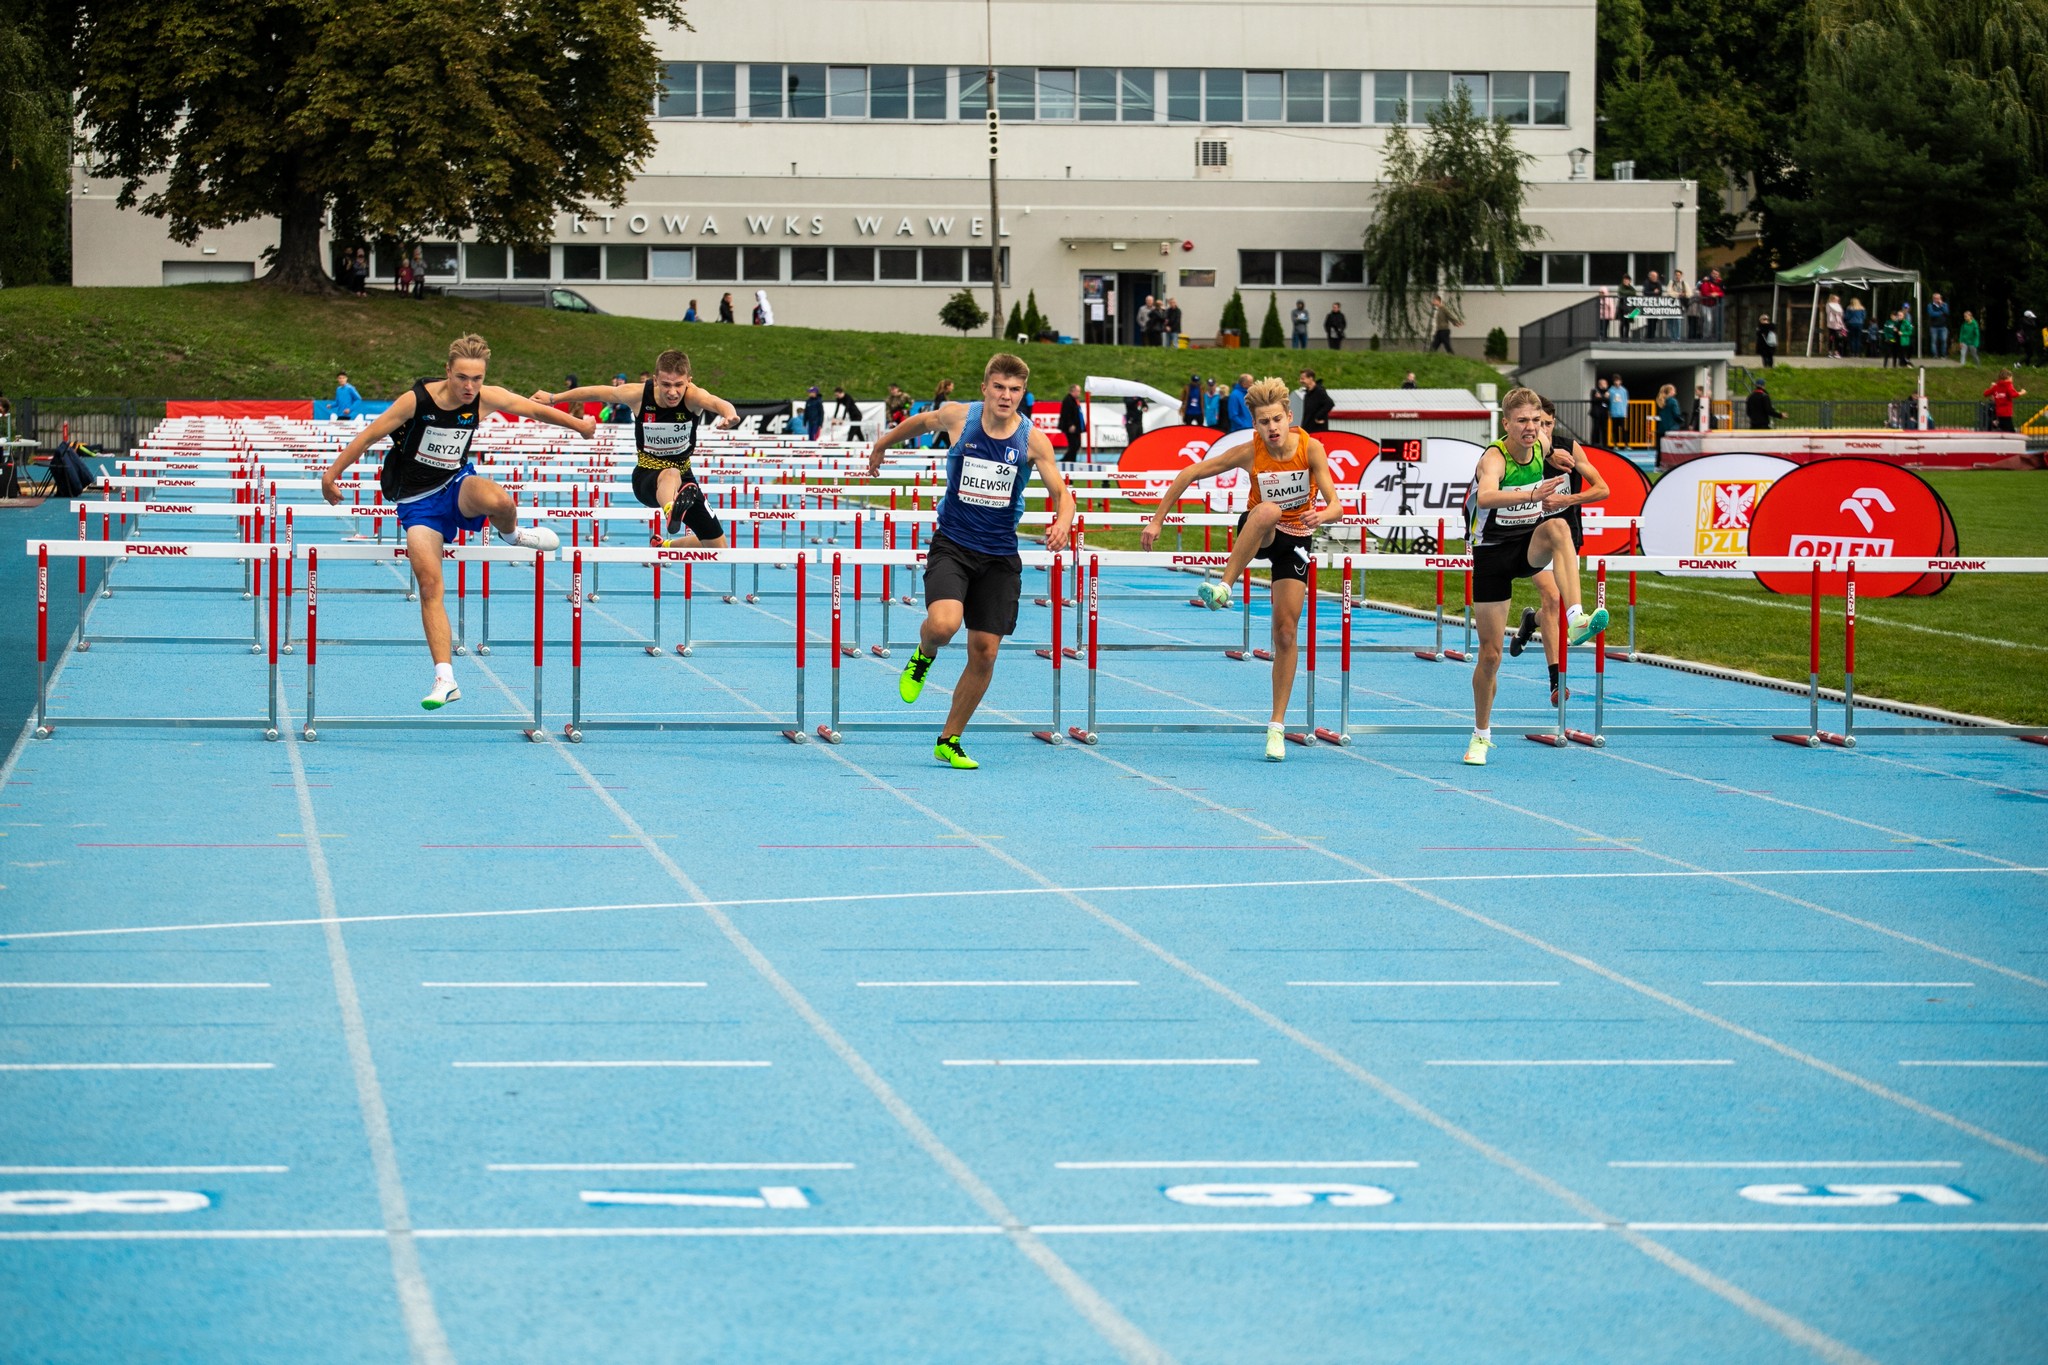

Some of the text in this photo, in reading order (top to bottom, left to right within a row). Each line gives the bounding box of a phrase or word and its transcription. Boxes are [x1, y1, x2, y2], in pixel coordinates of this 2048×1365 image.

[747, 215, 824, 236] WKS
[856, 216, 1010, 237] WAWEL
[1626, 297, 1680, 307] STRZELNICA
[674, 424, 687, 432] 34
[766, 415, 790, 434] 4F
[453, 431, 467, 440] 37
[427, 442, 461, 455] BRYZA
[1844, 441, 1883, 449] POLANIK
[995, 464, 1010, 476] 36
[1291, 472, 1304, 481] 17
[962, 475, 1011, 492] DELEWSKI
[1267, 485, 1304, 498] SAMUL
[1401, 483, 1471, 509] FUE
[963, 496, 991, 506] KRAKÓW
[145, 505, 192, 513] POLANIK
[547, 510, 593, 518] POLANIK
[749, 511, 796, 519] POLANIK
[1140, 515, 1185, 523] POANIK
[1699, 532, 1748, 554] PZL
[125, 545, 187, 555] POLANIK
[1795, 540, 1886, 561] ORLEN
[658, 551, 718, 561] POLANIK
[1425, 558, 1473, 568] POLANI
[1679, 560, 1737, 570] POLANIK
[1928, 561, 1986, 570] POLANIK
[578, 1188, 809, 1208] 7
[1738, 1184, 1974, 1205] 5
